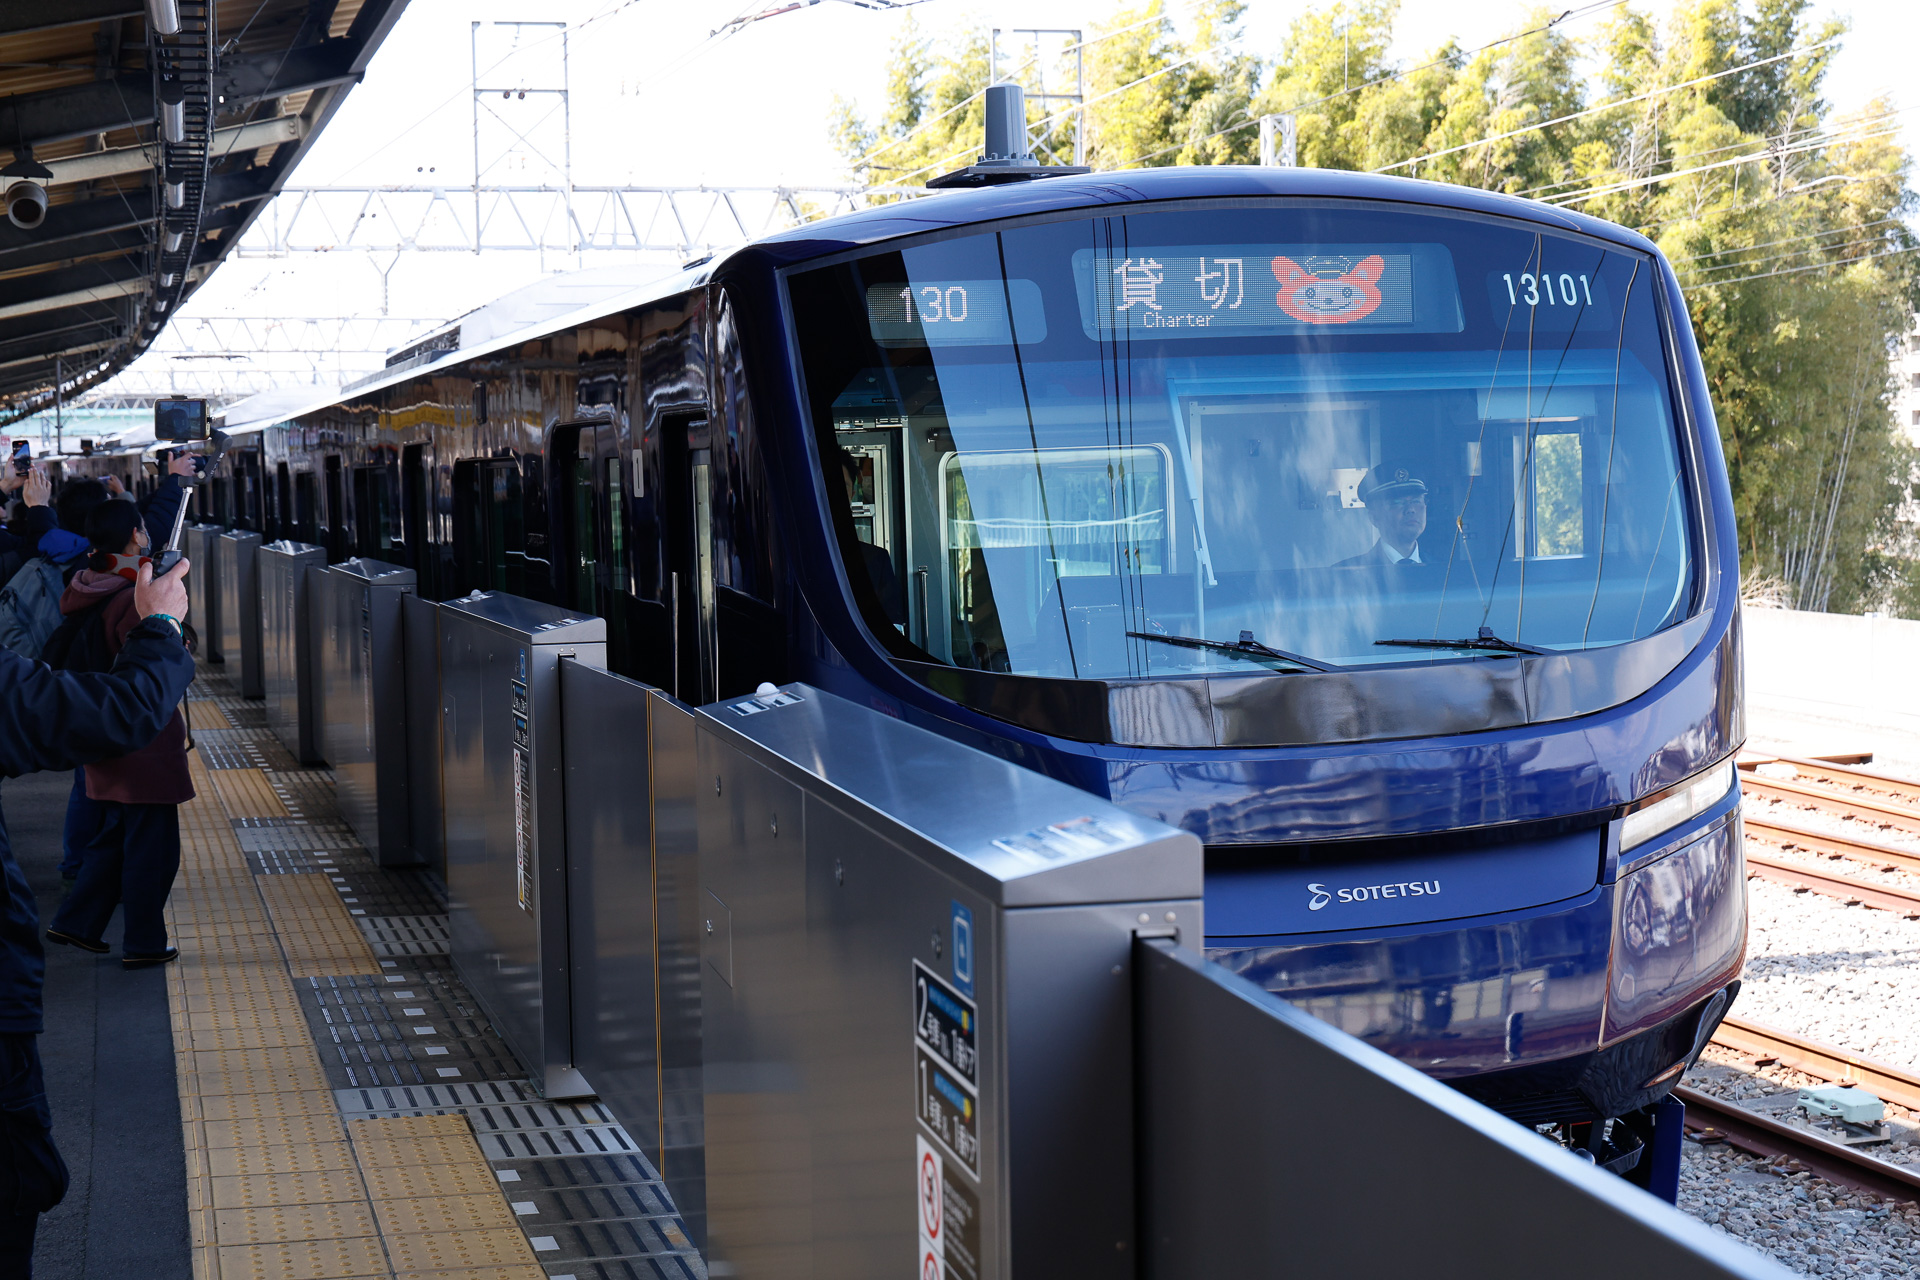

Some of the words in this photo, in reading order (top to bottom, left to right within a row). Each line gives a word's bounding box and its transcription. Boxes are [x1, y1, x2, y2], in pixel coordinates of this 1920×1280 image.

[1503, 273, 1592, 306] 13101
[900, 286, 967, 322] 130
[1143, 312, 1214, 327] Charter
[1337, 880, 1441, 903] SOTETSU
